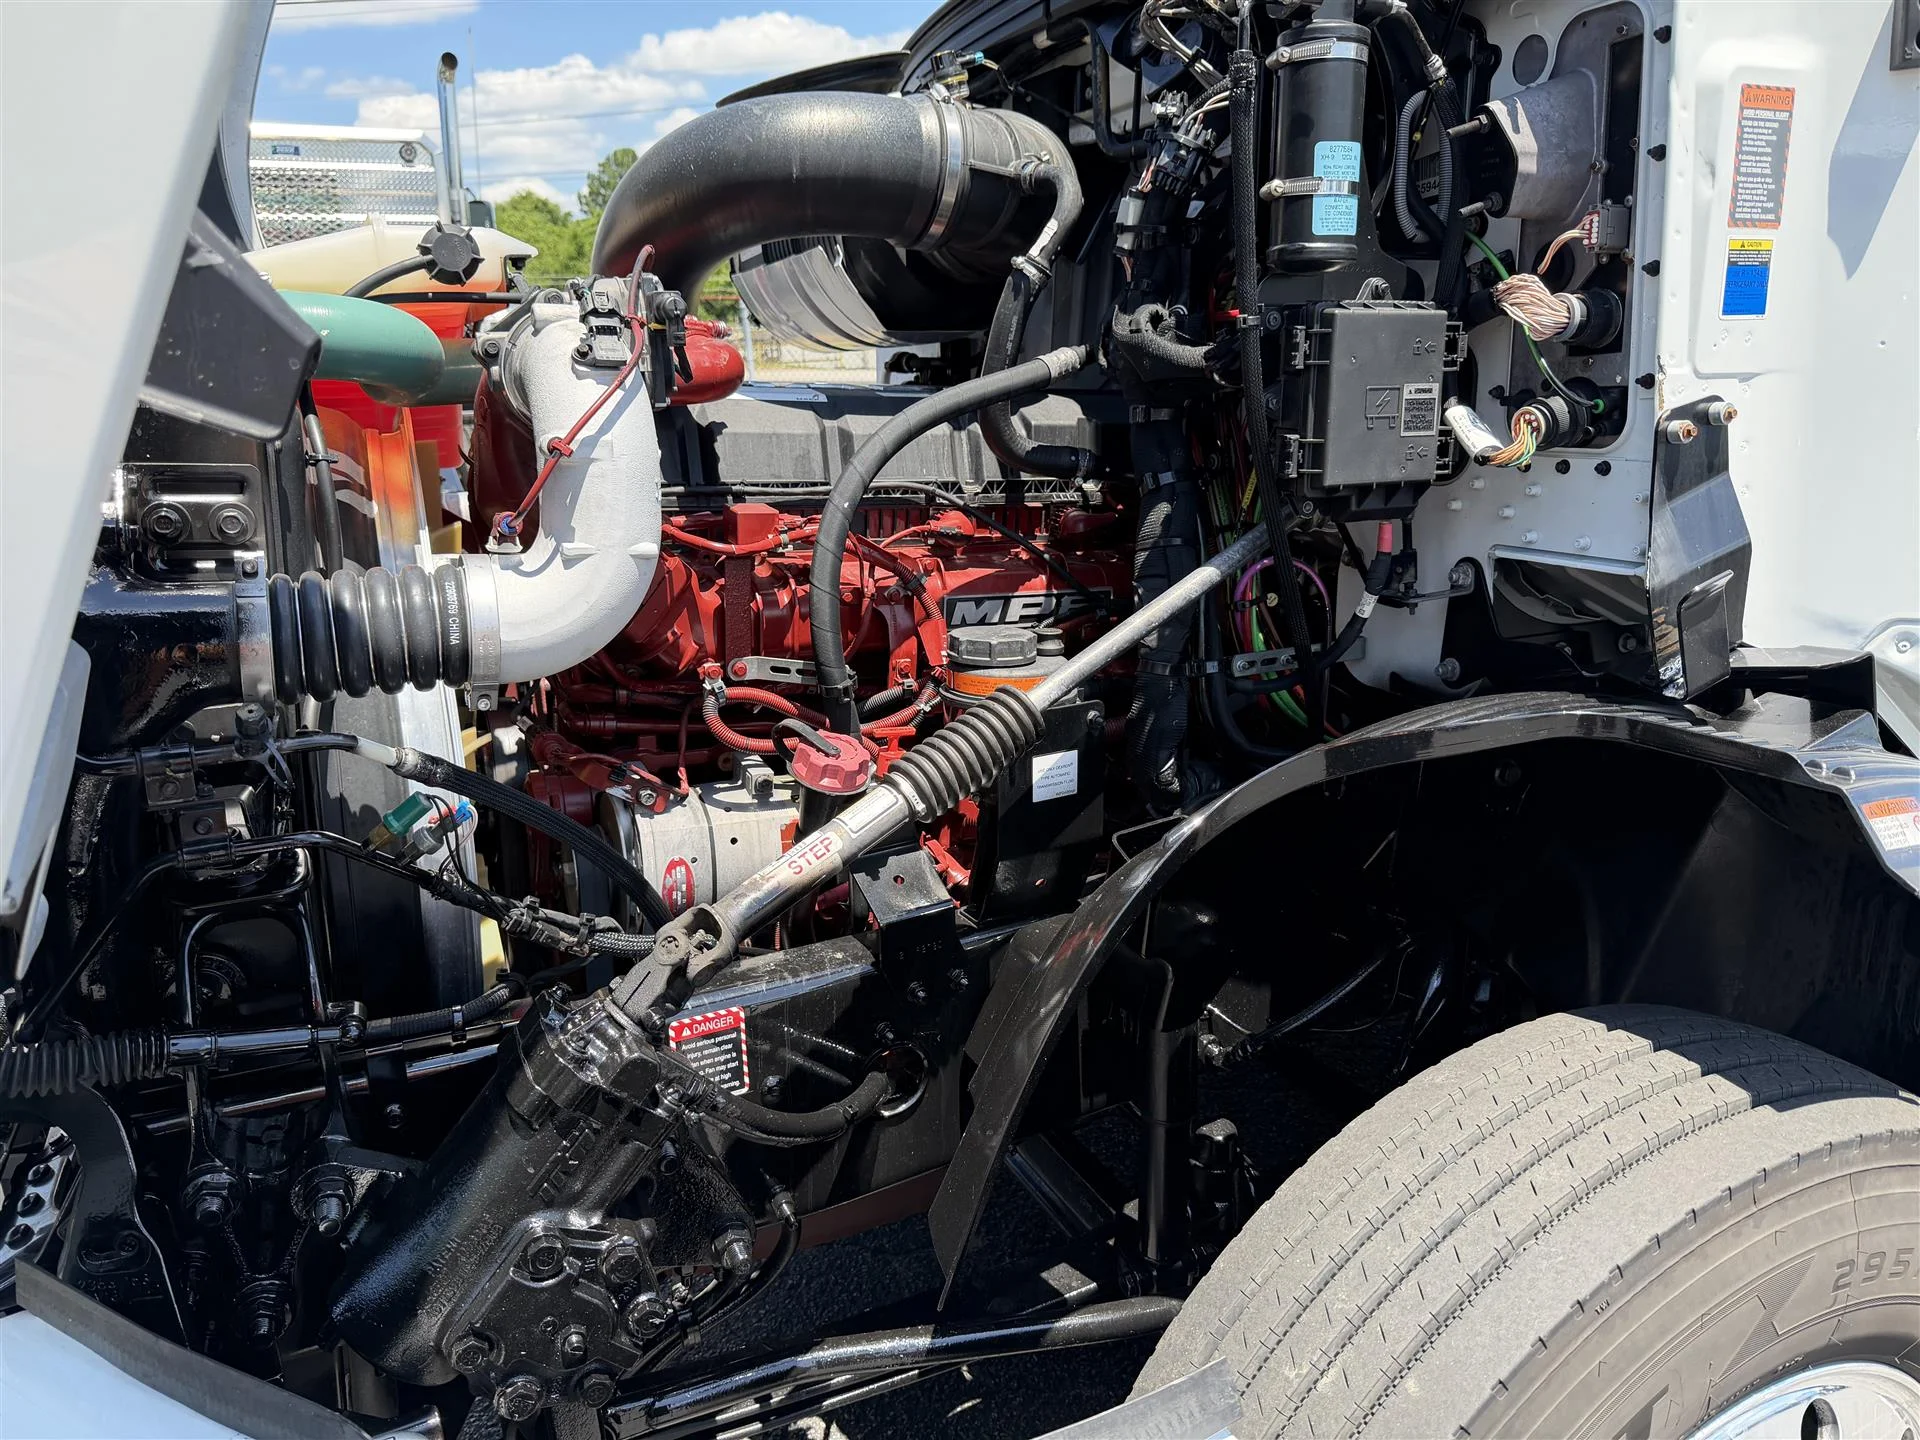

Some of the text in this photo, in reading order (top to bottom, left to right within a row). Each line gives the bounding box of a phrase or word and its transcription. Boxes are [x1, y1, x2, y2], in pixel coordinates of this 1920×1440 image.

[1753, 94, 1790, 105] WARNING
[449, 617, 460, 645] CHINA
[1876, 799, 1919, 814] WARNING
[788, 837, 833, 875] STEP
[693, 1016, 734, 1034] DANGER
[682, 1032, 736, 1050] Avoid serious personal
[703, 1047, 720, 1055] remain
[700, 1058, 713, 1066] when
[715, 1054, 731, 1062] engine
[721, 1072, 731, 1080] high
[1830, 1247, 1920, 1295] 295
